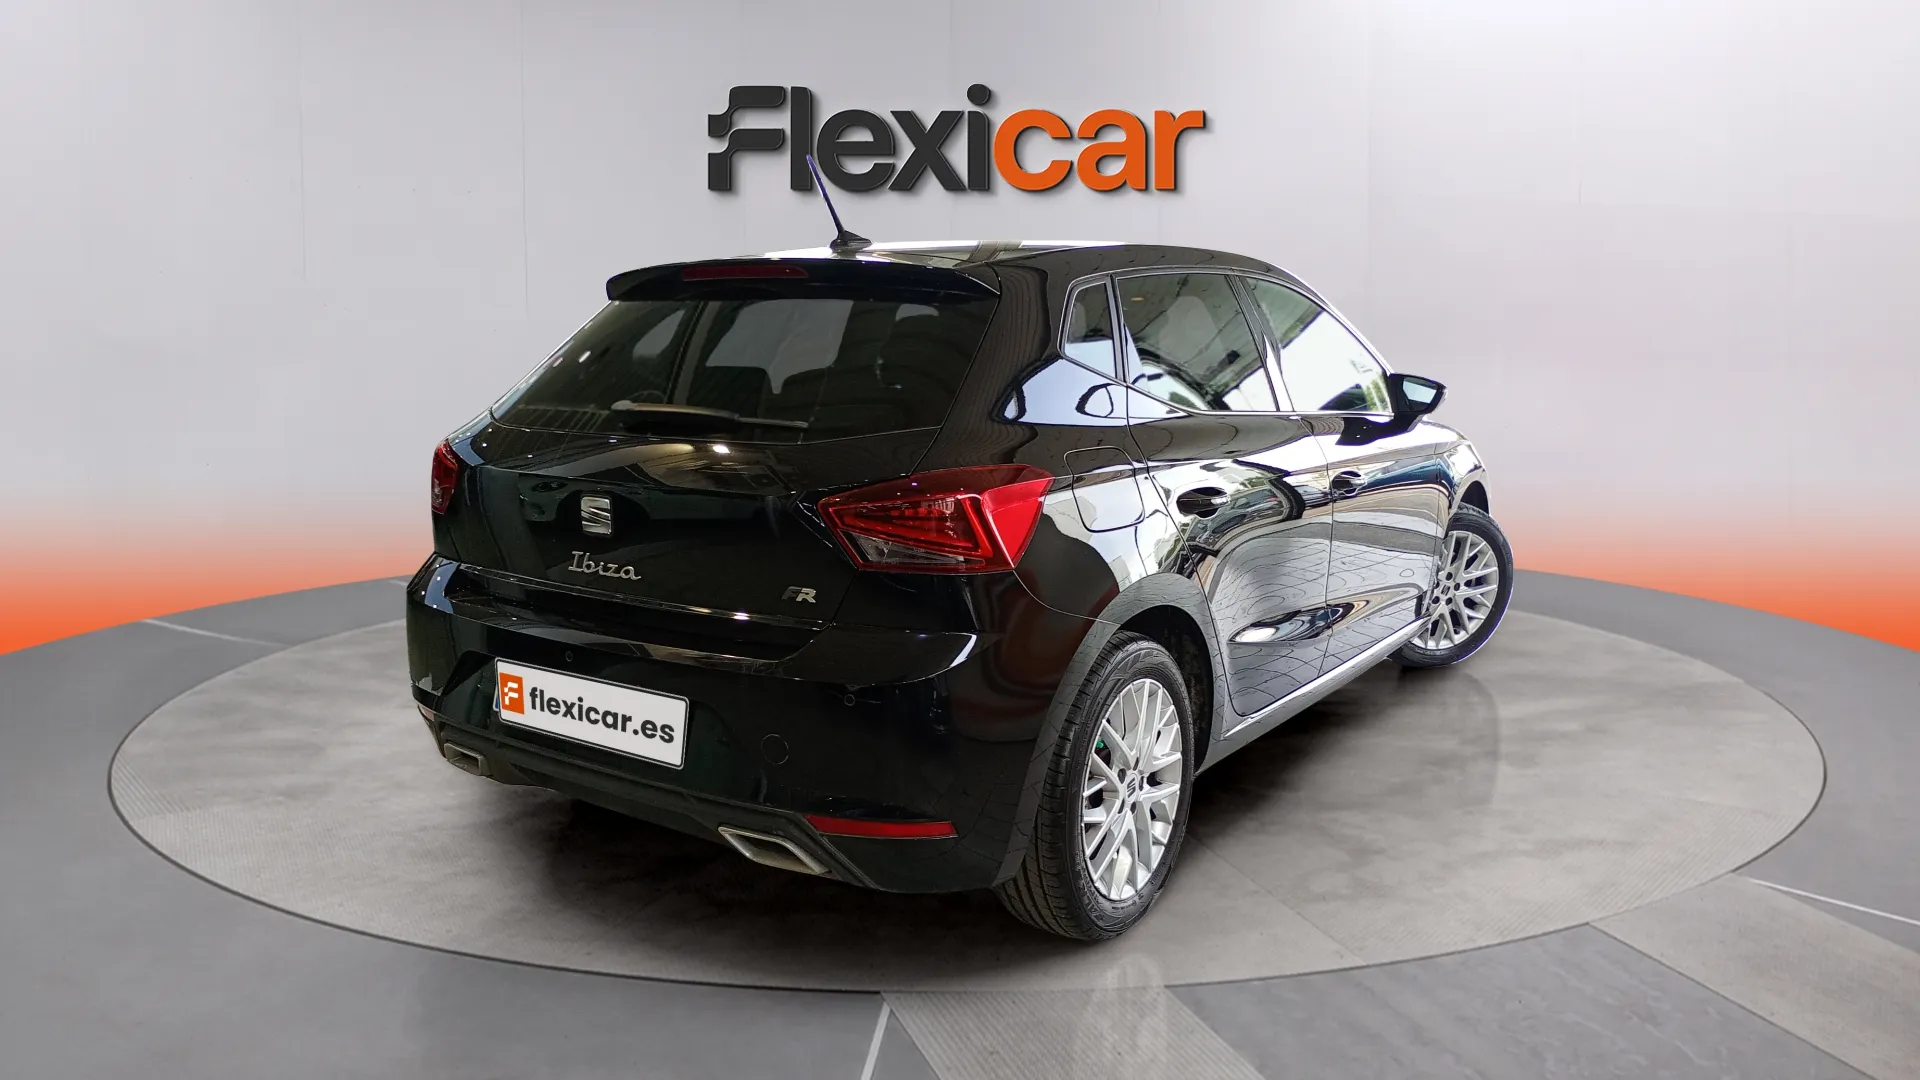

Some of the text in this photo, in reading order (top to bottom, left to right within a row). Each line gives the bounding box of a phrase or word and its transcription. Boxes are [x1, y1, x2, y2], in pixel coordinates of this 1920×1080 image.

[708, 84, 1205, 191] Flexicar
[567, 550, 642, 580] Ibiza
[781, 585, 817, 603] FR
[529, 686, 675, 744] flexicar.es
